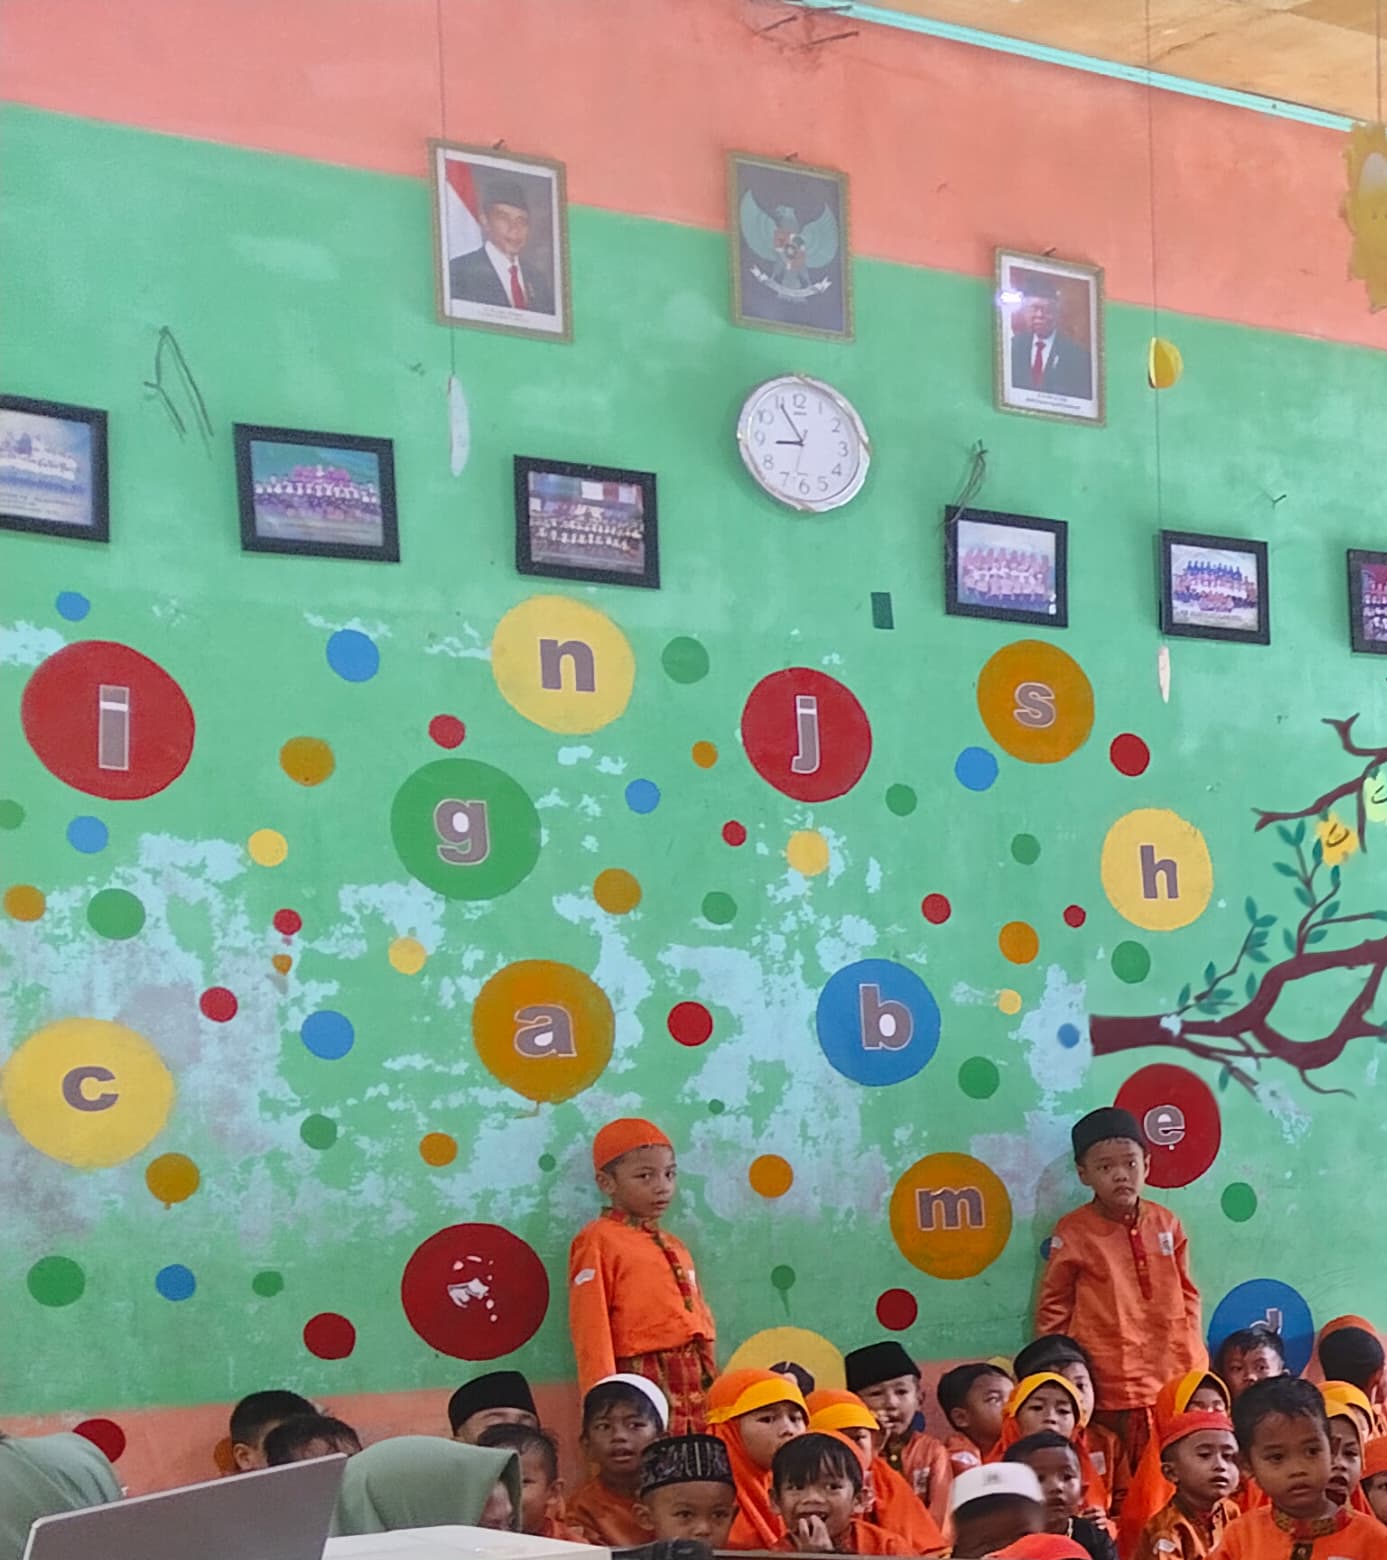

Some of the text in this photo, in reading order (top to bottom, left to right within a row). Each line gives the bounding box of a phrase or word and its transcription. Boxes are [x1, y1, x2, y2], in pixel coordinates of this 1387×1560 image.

[757, 409, 775, 425] 10
[793, 393, 807, 409] 12
[754, 431, 765, 447] 9
[831, 418, 841, 433] 2
[763, 455, 774, 471] 8
[831, 463, 842, 476] 4
[838, 441, 848, 457] 3
[779, 472, 790, 487] 7
[798, 477, 810, 495] 6
[817, 476, 829, 492] 5
[539, 638, 596, 692] n
[1013, 680, 1057, 730] s
[98, 685, 130, 772] i
[791, 695, 822, 775] j
[433, 798, 490, 866] g
[1140, 843, 1181, 900] h
[513, 1004, 576, 1059] a
[859, 983, 915, 1051] b
[62, 1065, 119, 1112] c
[1143, 1104, 1187, 1147] e
[915, 1185, 985, 1232] m
